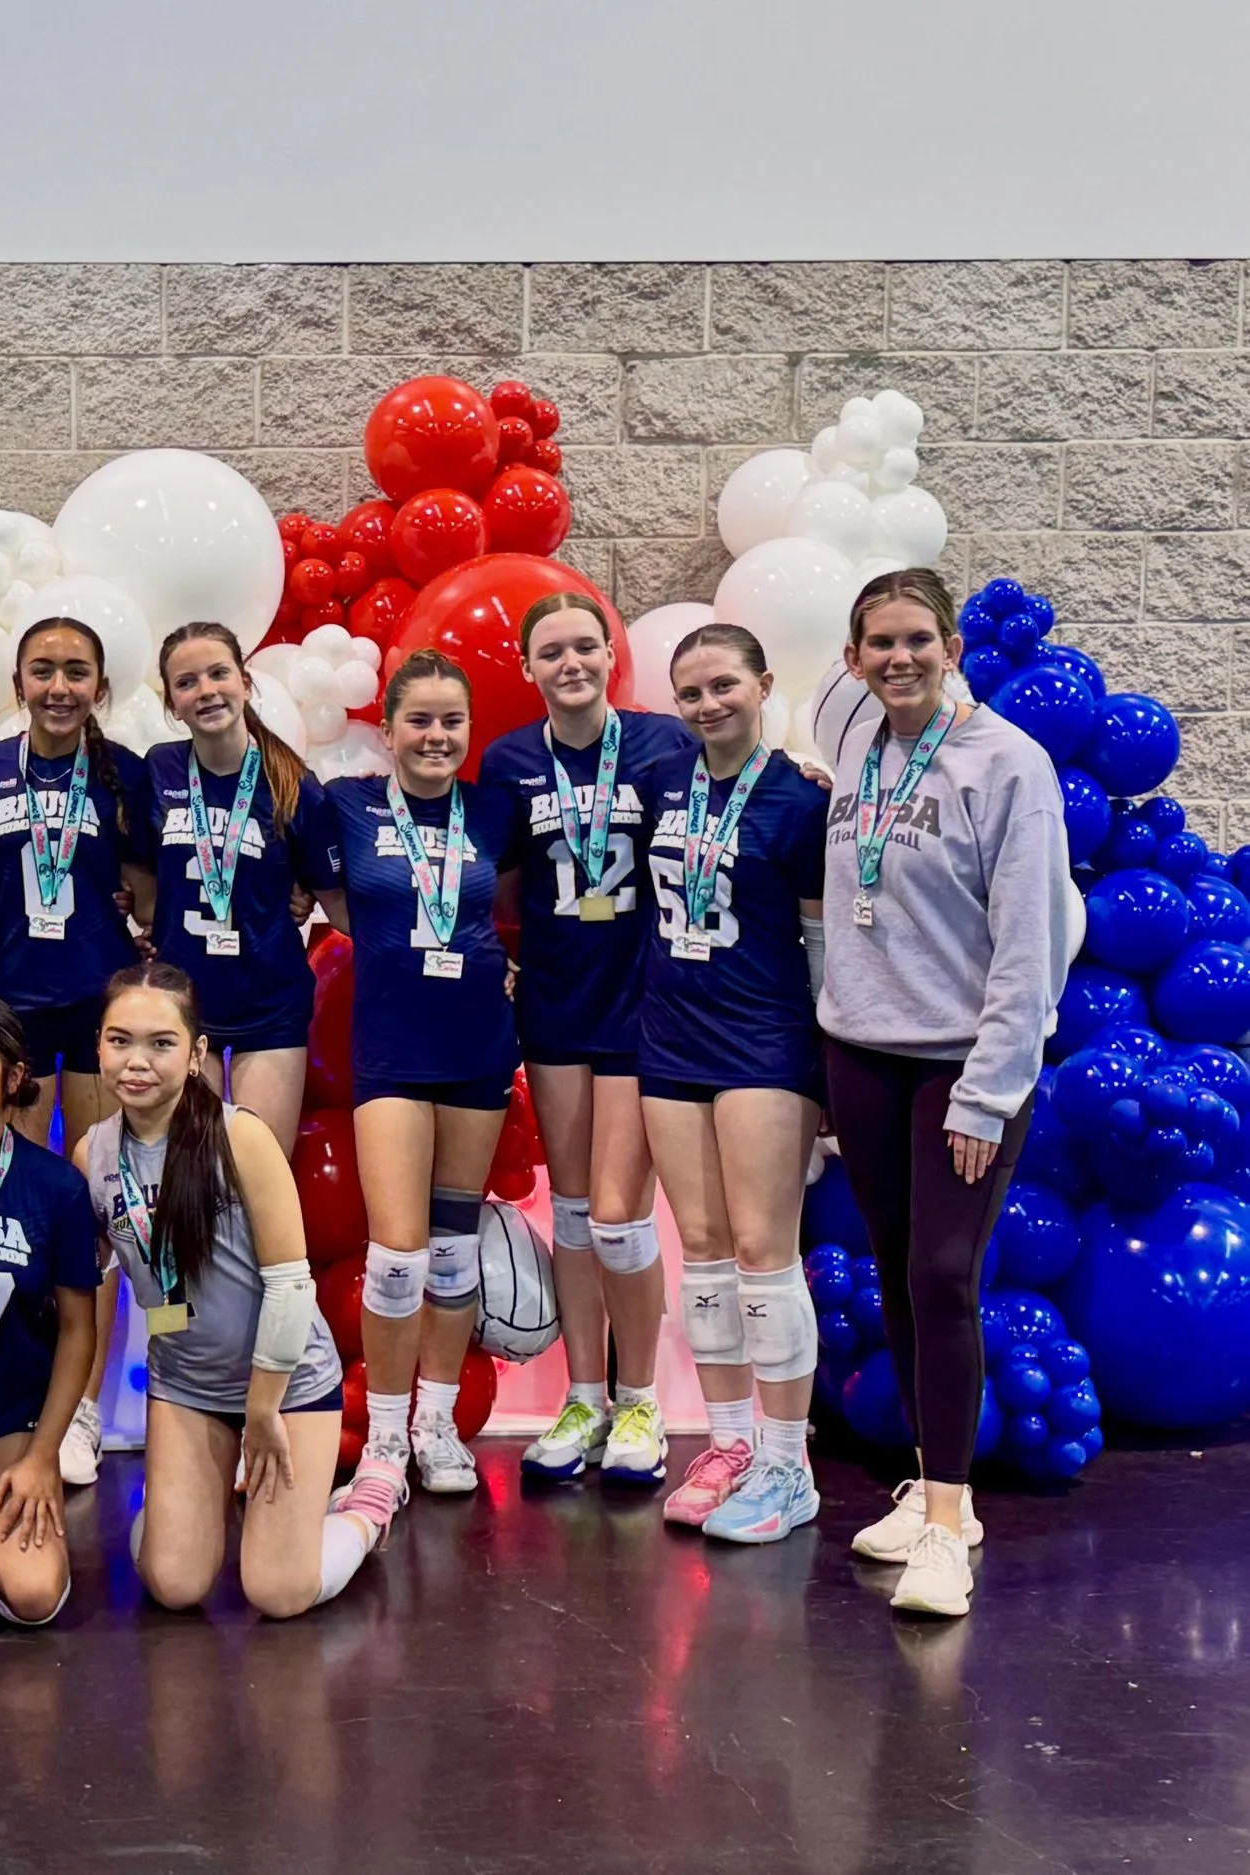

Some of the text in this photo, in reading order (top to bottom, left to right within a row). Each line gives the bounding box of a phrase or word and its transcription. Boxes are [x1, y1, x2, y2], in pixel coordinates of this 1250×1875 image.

[529, 784, 644, 824] BUA
[690, 790, 708, 834] Summer
[716, 800, 743, 842] Summer
[827, 788, 942, 838] BUSA
[162, 807, 265, 848] BUA
[400, 821, 423, 862] Summer
[547, 833, 636, 915] 12
